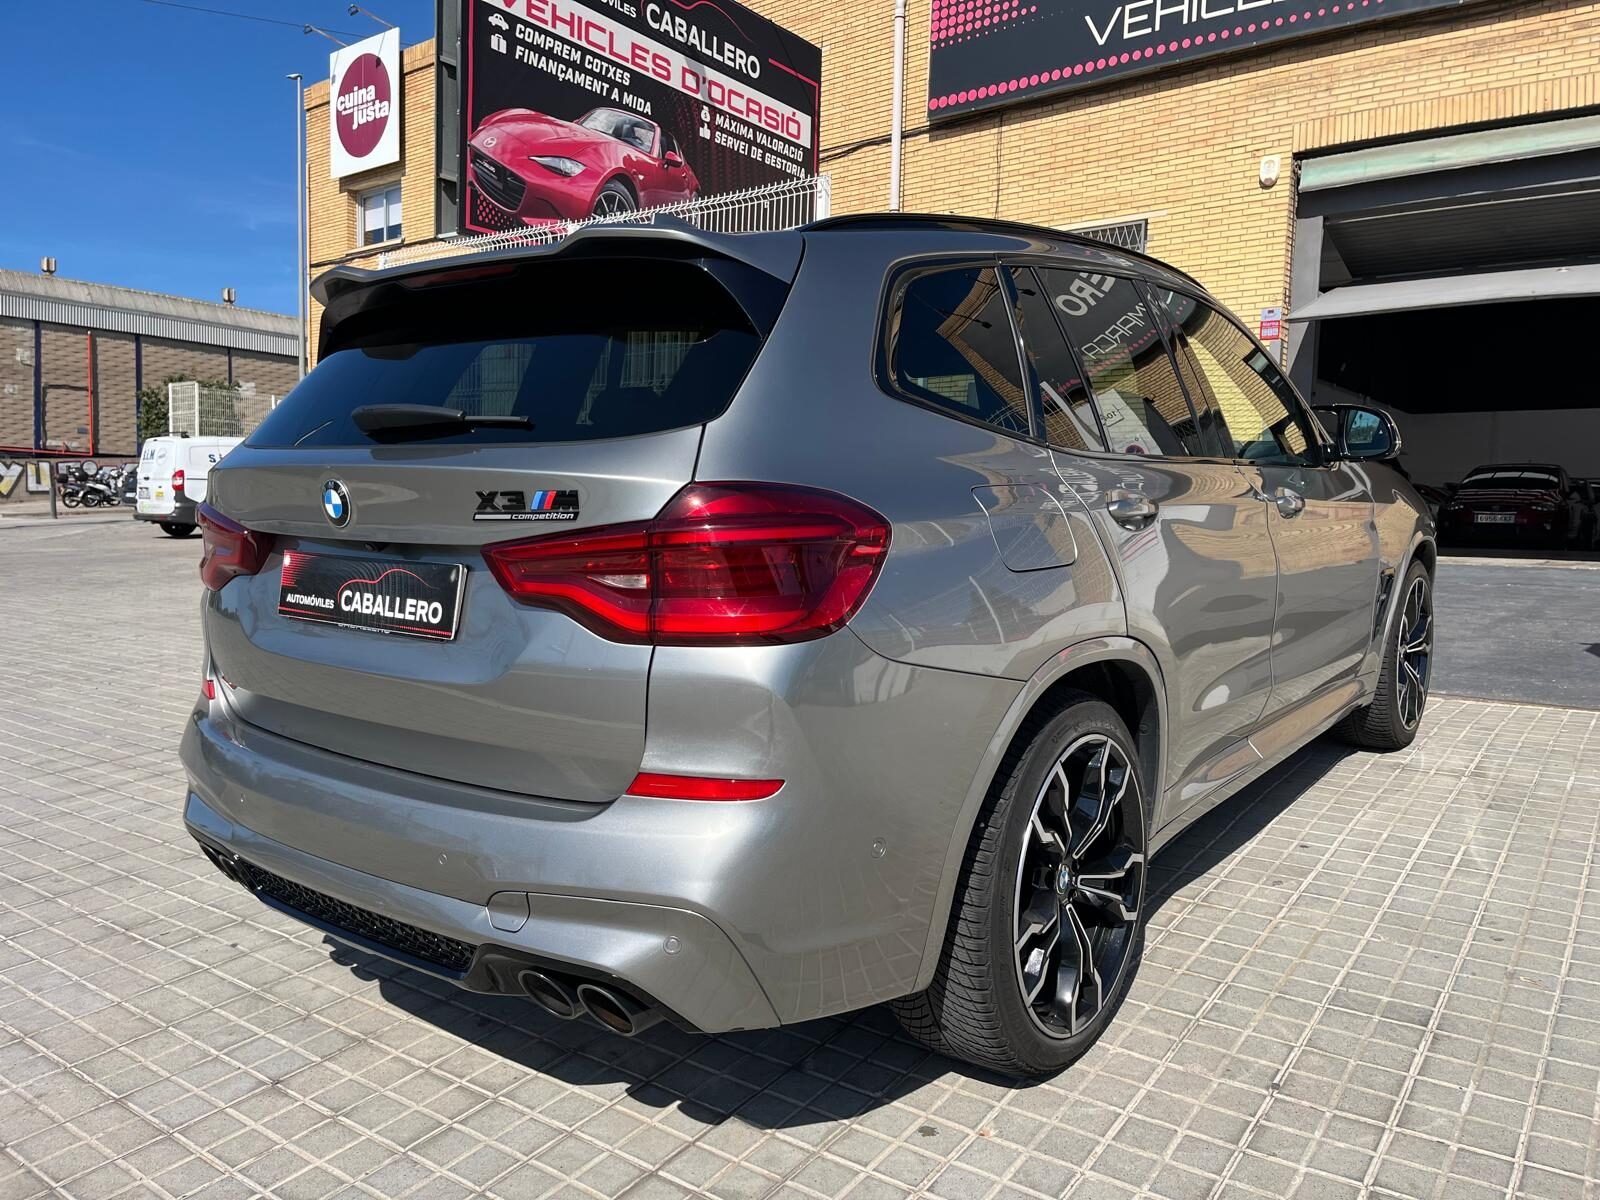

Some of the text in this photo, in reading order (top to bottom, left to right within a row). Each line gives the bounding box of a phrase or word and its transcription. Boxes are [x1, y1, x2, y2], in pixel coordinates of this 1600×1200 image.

[515, 23, 631, 86] COMPREM COTXES
[646, 3, 760, 79] CABALLERO
[337, 84, 376, 112] cuina
[515, 45, 652, 116] FINANÇAMENT A MIDA
[352, 99, 389, 130] justa
[681, 66, 801, 141] D'OCASIÓ
[714, 131, 749, 156] SERVEI
[750, 146, 763, 161] DE
[715, 113, 803, 162] MÀXIMA VALORACIÓ
[475, 490, 526, 510] X3
[511, 512, 575, 521] competition
[286, 589, 443, 624] AUTOMÓVILES CABALLERO
